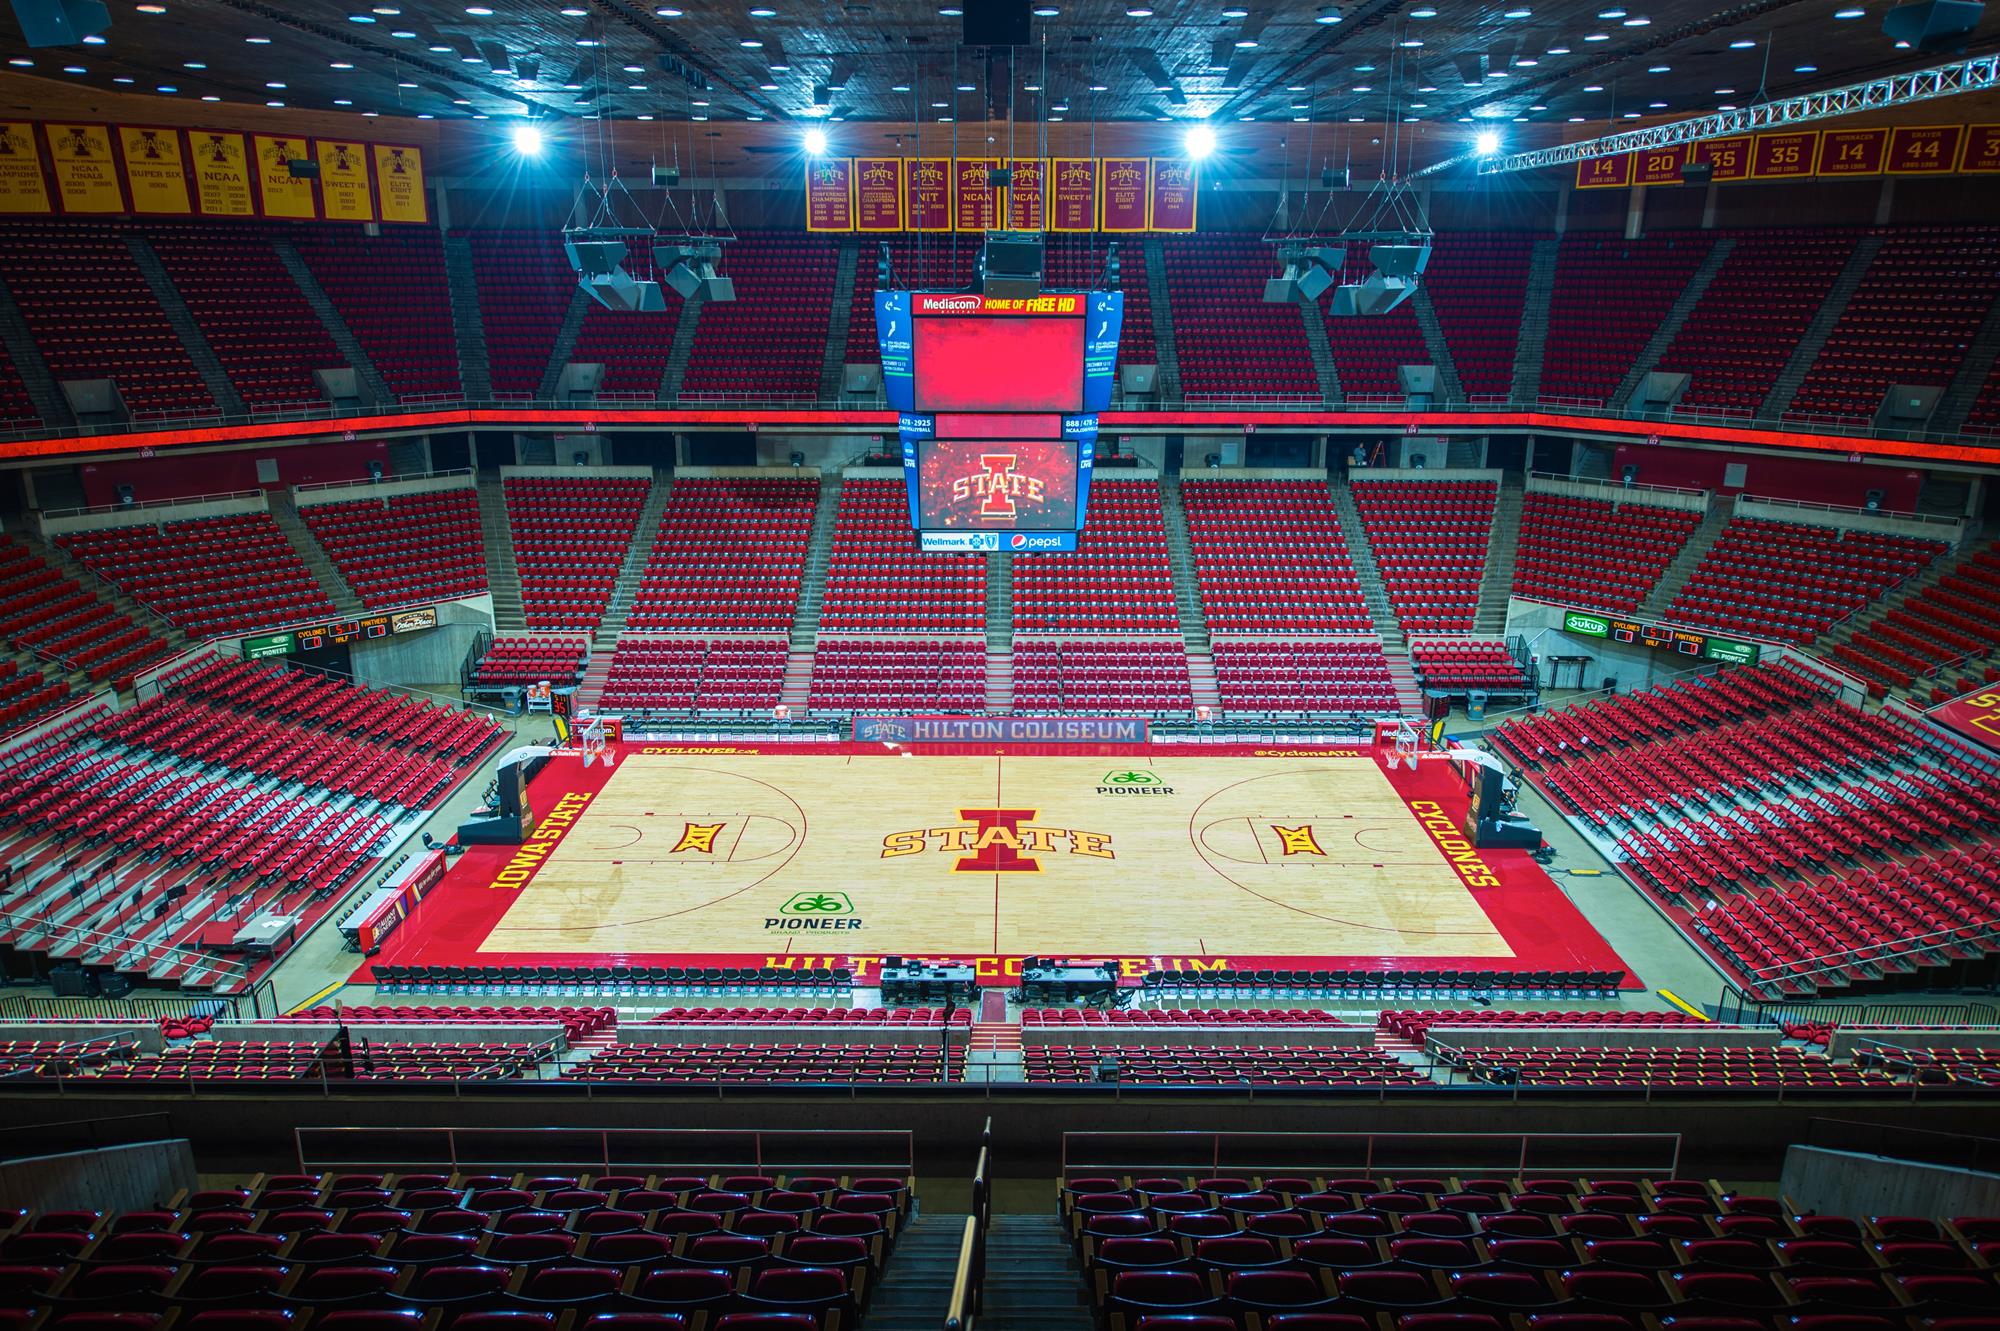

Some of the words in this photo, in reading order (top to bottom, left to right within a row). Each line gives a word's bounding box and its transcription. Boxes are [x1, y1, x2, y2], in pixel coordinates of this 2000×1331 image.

[1771, 147, 1799, 163] 35
[1840, 144, 1864, 160] 14
[1907, 141, 1940, 158] 44
[1648, 156, 1674, 171] 20
[1710, 150, 1735, 167] 35
[1593, 159, 1614, 175] 14
[131, 170, 163, 178] SUPER
[165, 170, 182, 178] SIX
[204, 172, 241, 182] NCAA
[325, 181, 355, 189] SWEET
[919, 193, 939, 202] NIT
[963, 193, 991, 201] NCAA
[1013, 193, 1040, 201] NCAA
[924, 298, 976, 309] Mediacom
[985, 299, 1010, 309] HOME
[1012, 300, 1025, 309] OF
[1026, 297, 1055, 312] FREE
[1057, 297, 1076, 312] HD
[953, 472, 1044, 503] STATE
[923, 536, 966, 546] Wellmark
[1029, 535, 1062, 551] pepsi
[361, 617, 388, 628] PANTHERS
[415, 617, 433, 626] Place
[1570, 616, 1604, 632] Sukup
[1613, 621, 1641, 632] CYCLONES
[298, 628, 326, 639] CYCLONES
[378, 626, 385, 636] 0
[1625, 632, 1632, 641] 0
[313, 637, 321, 647] 0
[1675, 632, 1703, 644] PANTHERS
[262, 647, 287, 657] PIONEER
[1690, 643, 1697, 653] 0
[1721, 653, 1746, 664] PIONEER
[864, 721, 906, 738] STATE
[914, 721, 1003, 739] HILTON
[1010, 721, 1136, 739] COLISEUM
[1254, 749, 1359, 758] @CycloneATH
[531, 792, 592, 839] STATE
[880, 826, 1115, 859] STATE
[1410, 800, 1501, 886] CYCLONES
[490, 841, 553, 889] IOWA
[764, 918, 862, 929] PIONEER
